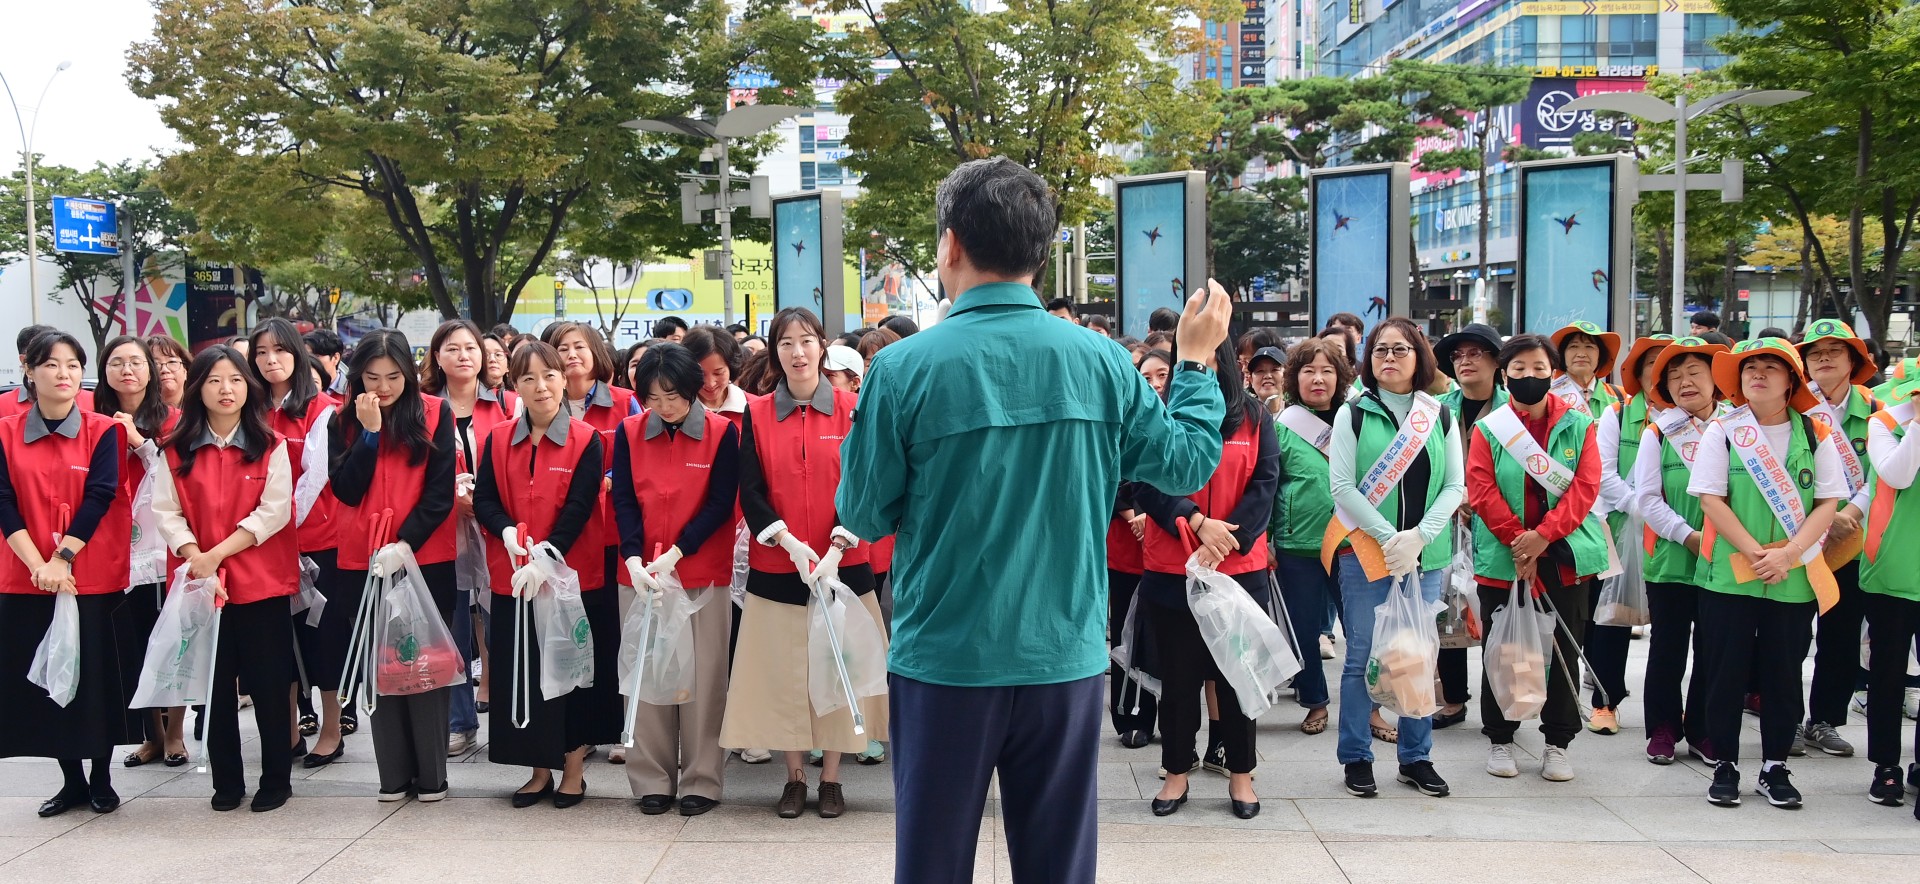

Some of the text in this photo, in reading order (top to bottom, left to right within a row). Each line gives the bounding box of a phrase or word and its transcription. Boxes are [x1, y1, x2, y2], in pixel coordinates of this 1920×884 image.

[1599, 64, 1643, 77] 심리상담
[1645, 65, 1659, 76] 3F
[1444, 208, 1457, 230] IBK
[194, 270, 220, 281] 365일
